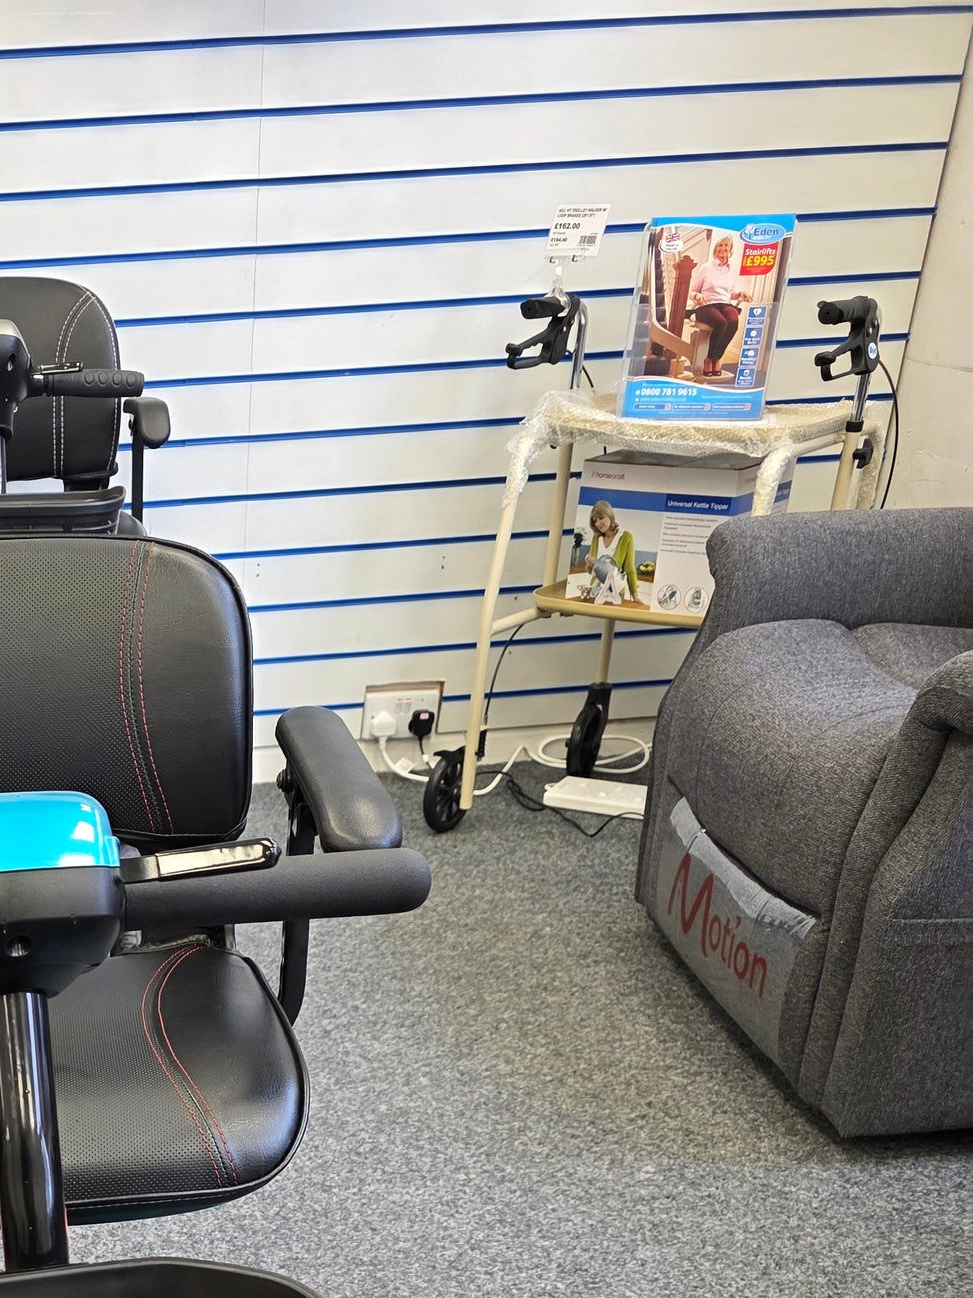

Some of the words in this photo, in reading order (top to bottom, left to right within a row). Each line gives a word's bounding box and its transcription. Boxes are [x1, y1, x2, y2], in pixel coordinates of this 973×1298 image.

[554, 222, 581, 230] £162.00
[753, 227, 779, 236] Eden
[745, 248, 776, 256] Stairlifts
[745, 255, 775, 267] £995
[640, 387, 661, 396] 0800
[661, 387, 676, 396] 781
[677, 387, 698, 396] 9615
[595, 472, 626, 480] homecraft
[667, 500, 693, 508] Universal
[693, 501, 710, 509] Kettle
[710, 502, 729, 511] Tipper
[667, 853, 769, 998] Motion
